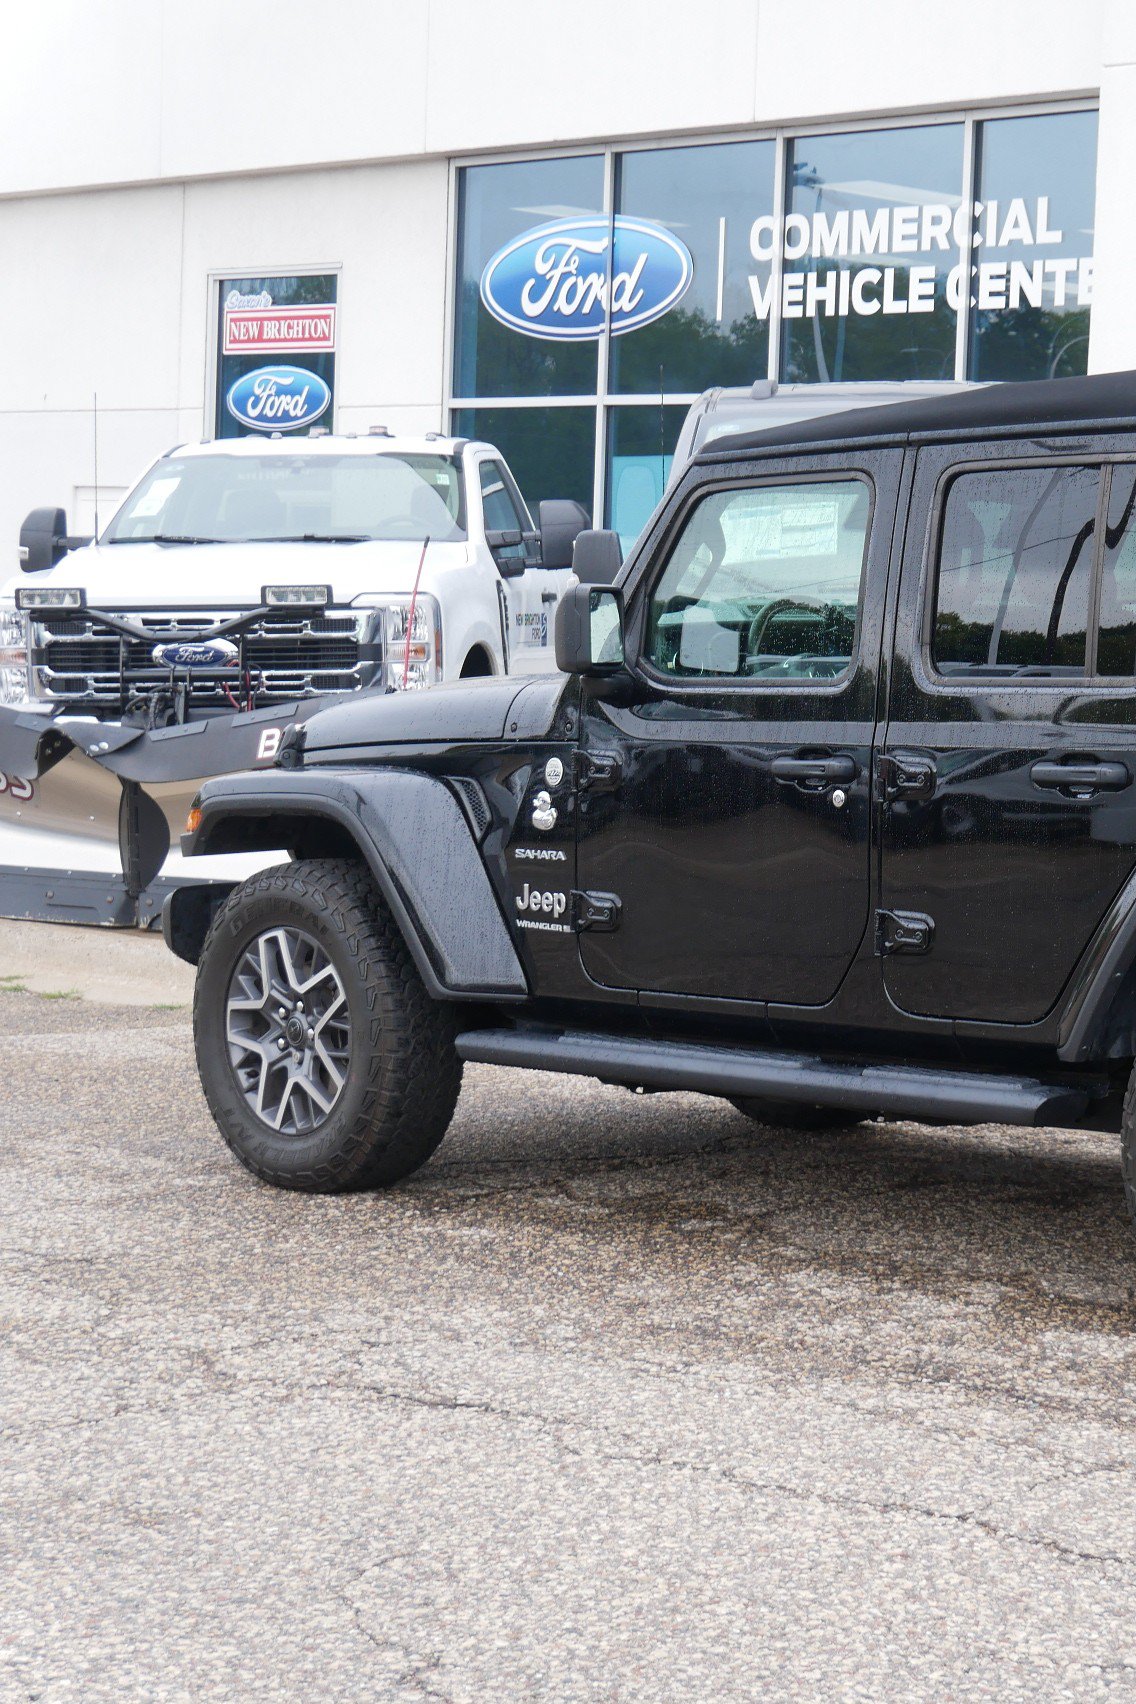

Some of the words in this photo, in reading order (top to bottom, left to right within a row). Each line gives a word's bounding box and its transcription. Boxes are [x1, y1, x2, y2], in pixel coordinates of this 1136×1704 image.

[749, 196, 1062, 262] COMMERCIAL
[521, 237, 648, 317] Ford
[748, 265, 935, 321] VEHICLE
[230, 321, 261, 341] NEW
[263, 318, 331, 340] BRIGHTON
[247, 375, 310, 417] Ford
[175, 646, 214, 662] Ford
[515, 848, 567, 861] SAHARA
[515, 883, 566, 919] Jeep
[516, 919, 563, 932] WRANGLER
